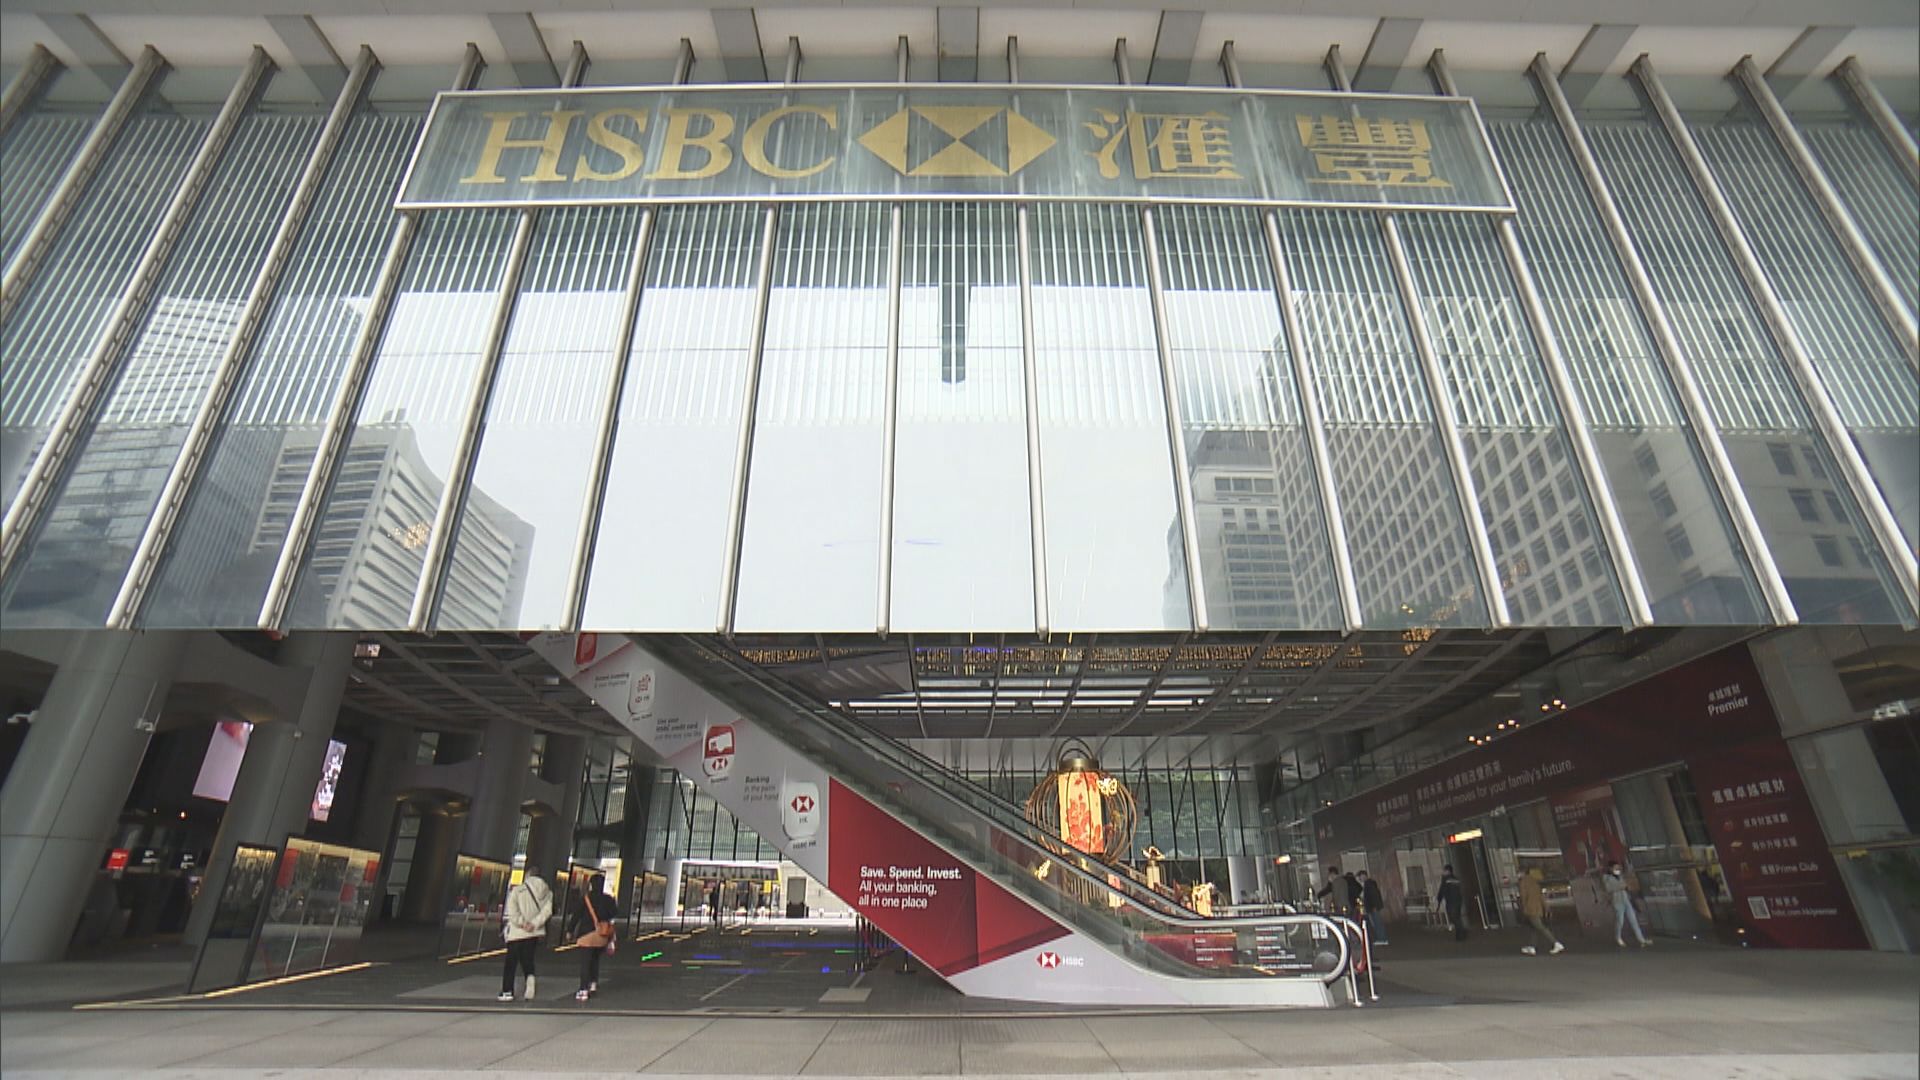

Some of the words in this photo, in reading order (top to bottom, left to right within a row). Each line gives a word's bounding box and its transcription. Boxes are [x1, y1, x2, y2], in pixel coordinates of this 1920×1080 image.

[459, 104, 838, 184] HSBC
[1707, 696, 1749, 717] Premier
[745, 775, 770, 784] Banking
[1476, 785, 1488, 798] for
[1488, 781, 1508, 798] your
[1508, 767, 1542, 788] family's
[1542, 760, 1576, 778] future.
[860, 865, 887, 878] Save.
[889, 865, 924, 882] Spend.
[927, 865, 963, 880] Invest.
[1799, 861, 1819, 872] Club
[859, 880, 872, 892] All
[873, 882, 895, 895] your
[896, 880, 938, 897] banking,
[858, 894, 869, 906] all
[871, 894, 880, 906] in
[881, 897, 900, 907] one
[901, 895, 928, 910] place
